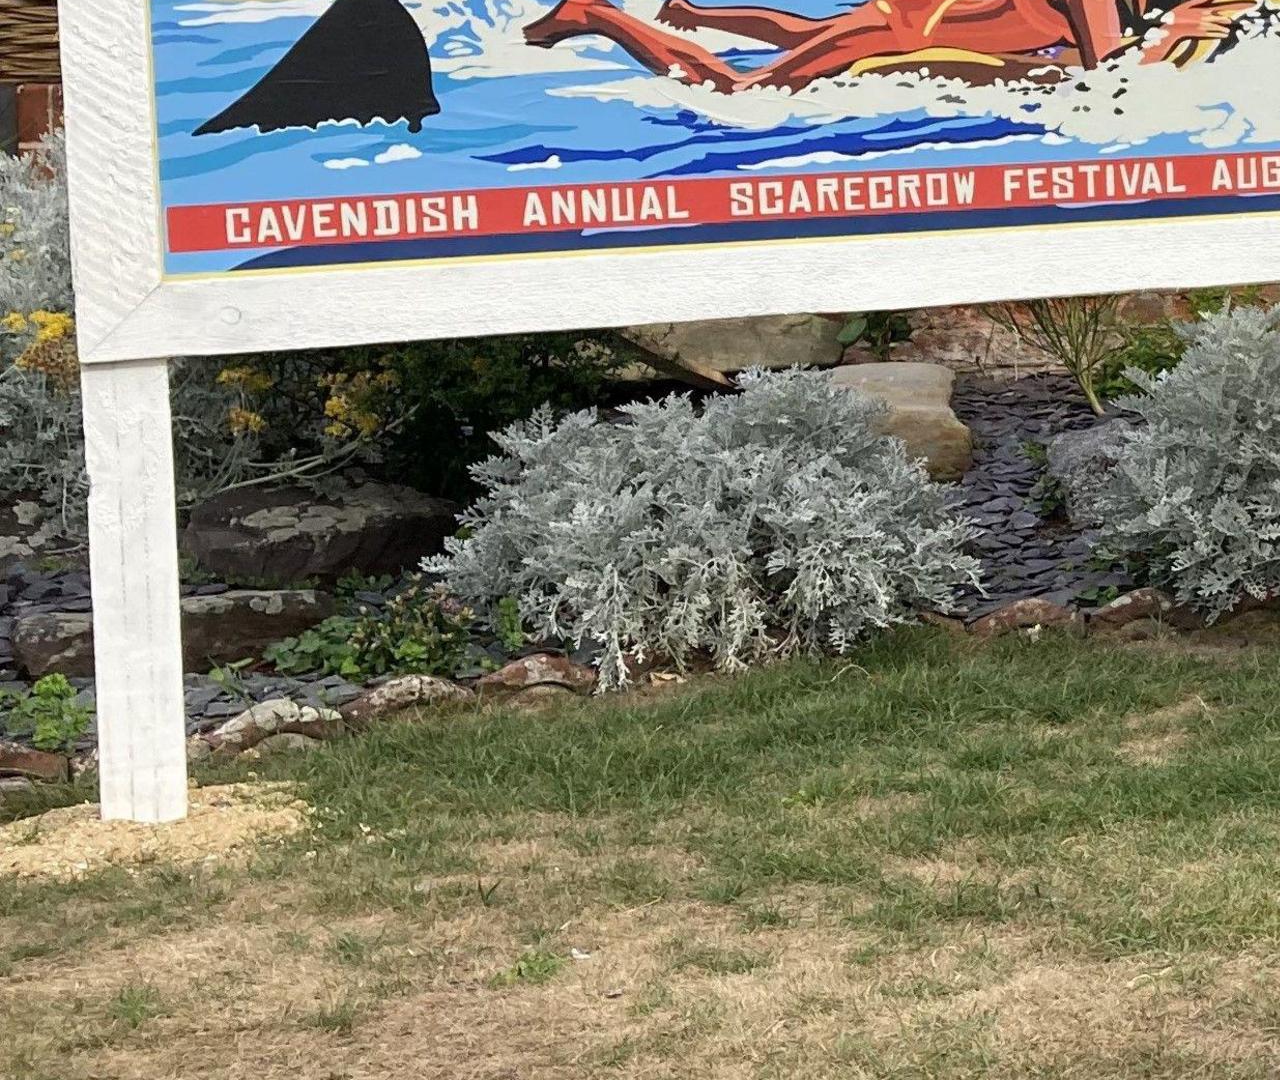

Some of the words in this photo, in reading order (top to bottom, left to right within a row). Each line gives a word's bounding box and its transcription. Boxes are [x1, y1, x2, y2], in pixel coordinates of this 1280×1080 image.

[225, 193, 480, 244] CAVENDISH
[522, 183, 689, 226] ANNUAL
[729, 171, 975, 216] SCARECROW
[1003, 157, 1186, 201] FESTIVAL
